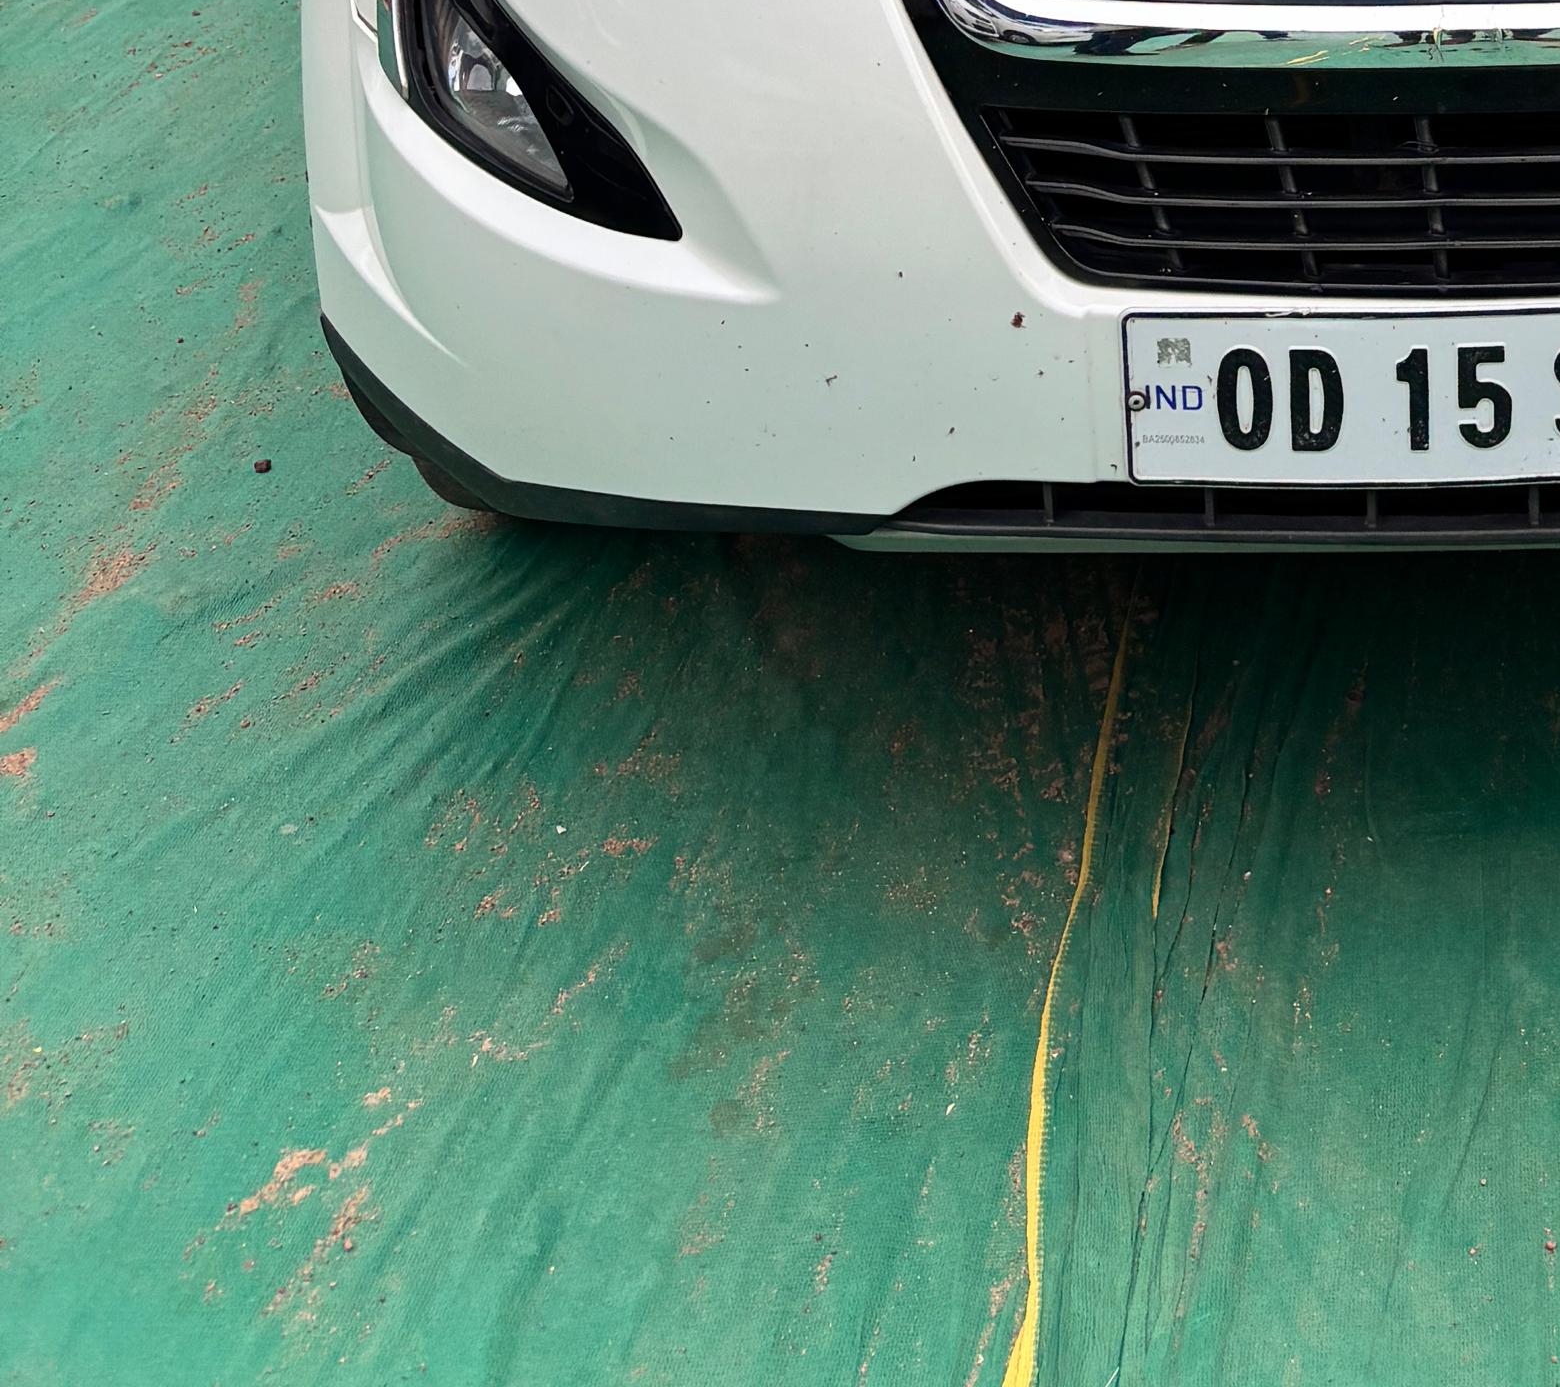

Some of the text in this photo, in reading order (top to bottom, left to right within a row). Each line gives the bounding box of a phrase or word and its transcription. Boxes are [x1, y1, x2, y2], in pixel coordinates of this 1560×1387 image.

[1144, 385, 1203, 410] IND
[1216, 346, 1345, 452] OD
[1395, 344, 1513, 452] 15
